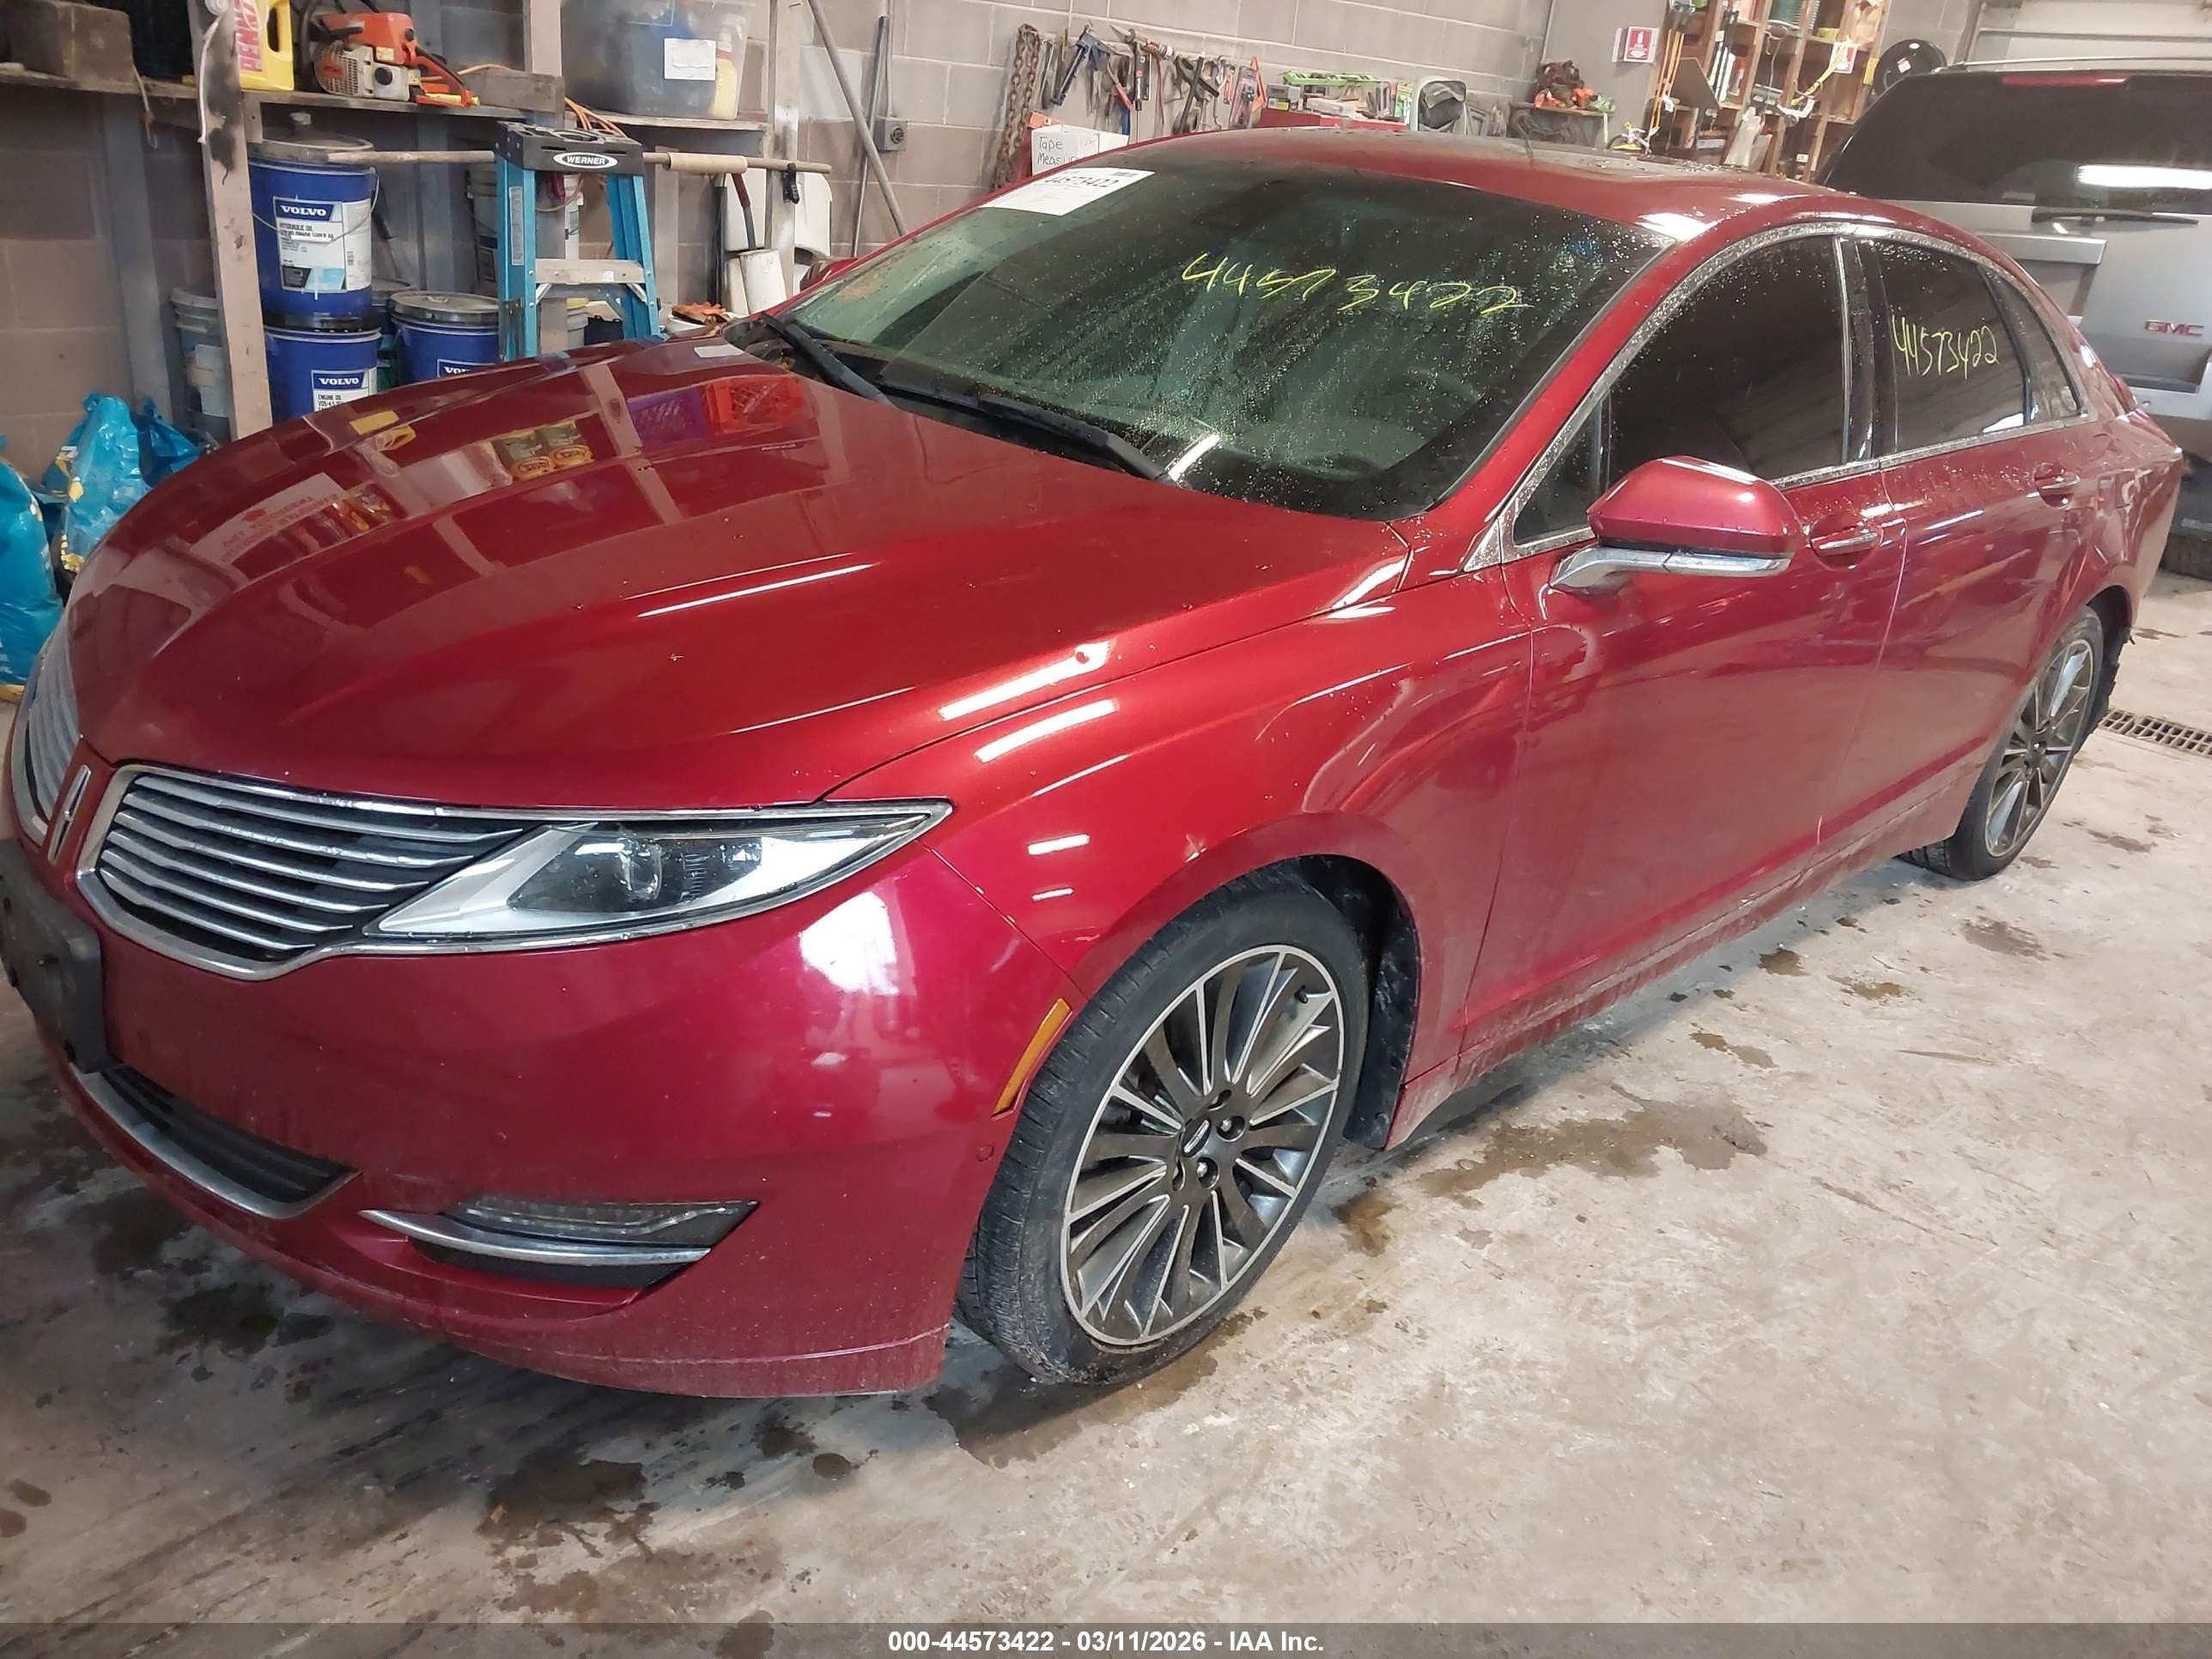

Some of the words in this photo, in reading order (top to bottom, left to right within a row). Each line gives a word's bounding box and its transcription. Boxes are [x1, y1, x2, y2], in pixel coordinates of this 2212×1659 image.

[1039, 137, 1063, 152] Tape
[567, 155, 605, 165] WERNER
[280, 205, 326, 216] VOLVO
[1182, 253, 1535, 317] 44573422
[2144, 320, 2203, 337] GMC
[1892, 314, 1999, 380] 44573422
